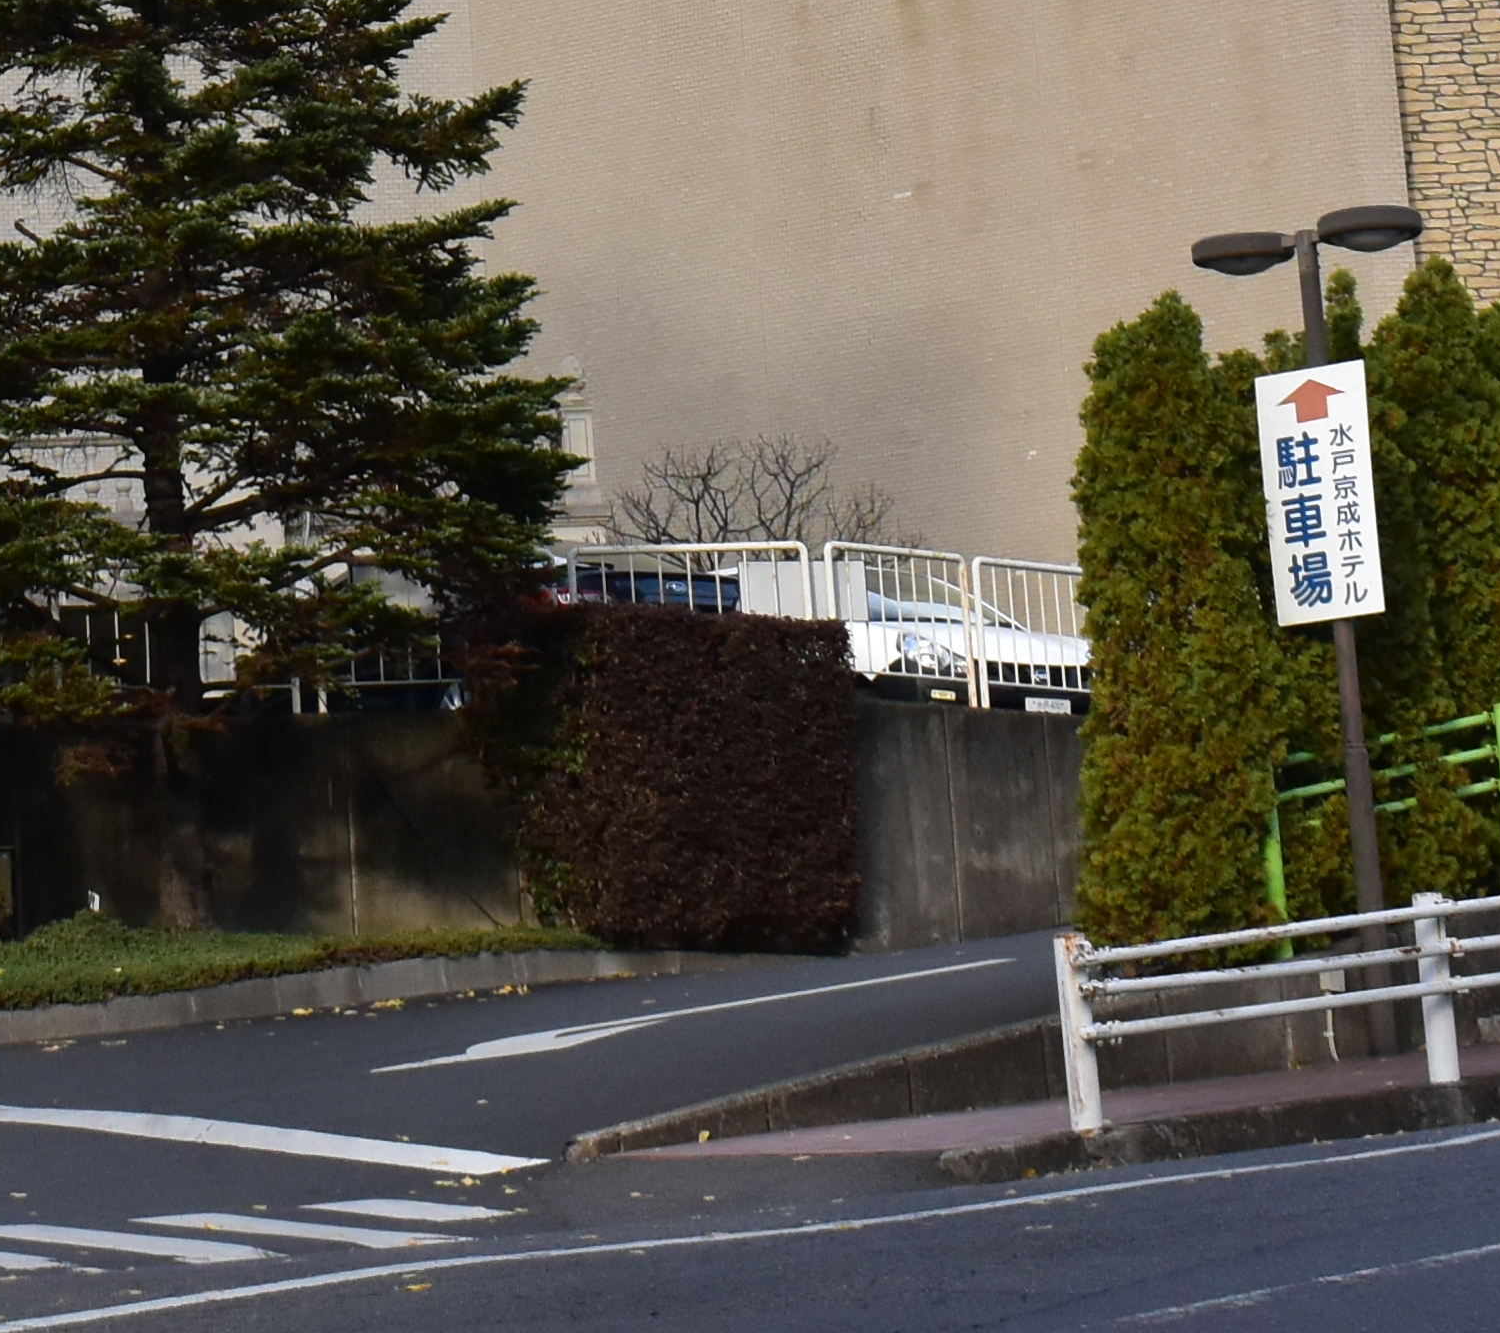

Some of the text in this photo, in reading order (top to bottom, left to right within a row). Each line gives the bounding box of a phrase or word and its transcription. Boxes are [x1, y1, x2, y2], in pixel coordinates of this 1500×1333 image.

[1276, 432, 1333, 608] 駐車場
[1329, 423, 1368, 606] 水戸京成ホテル
